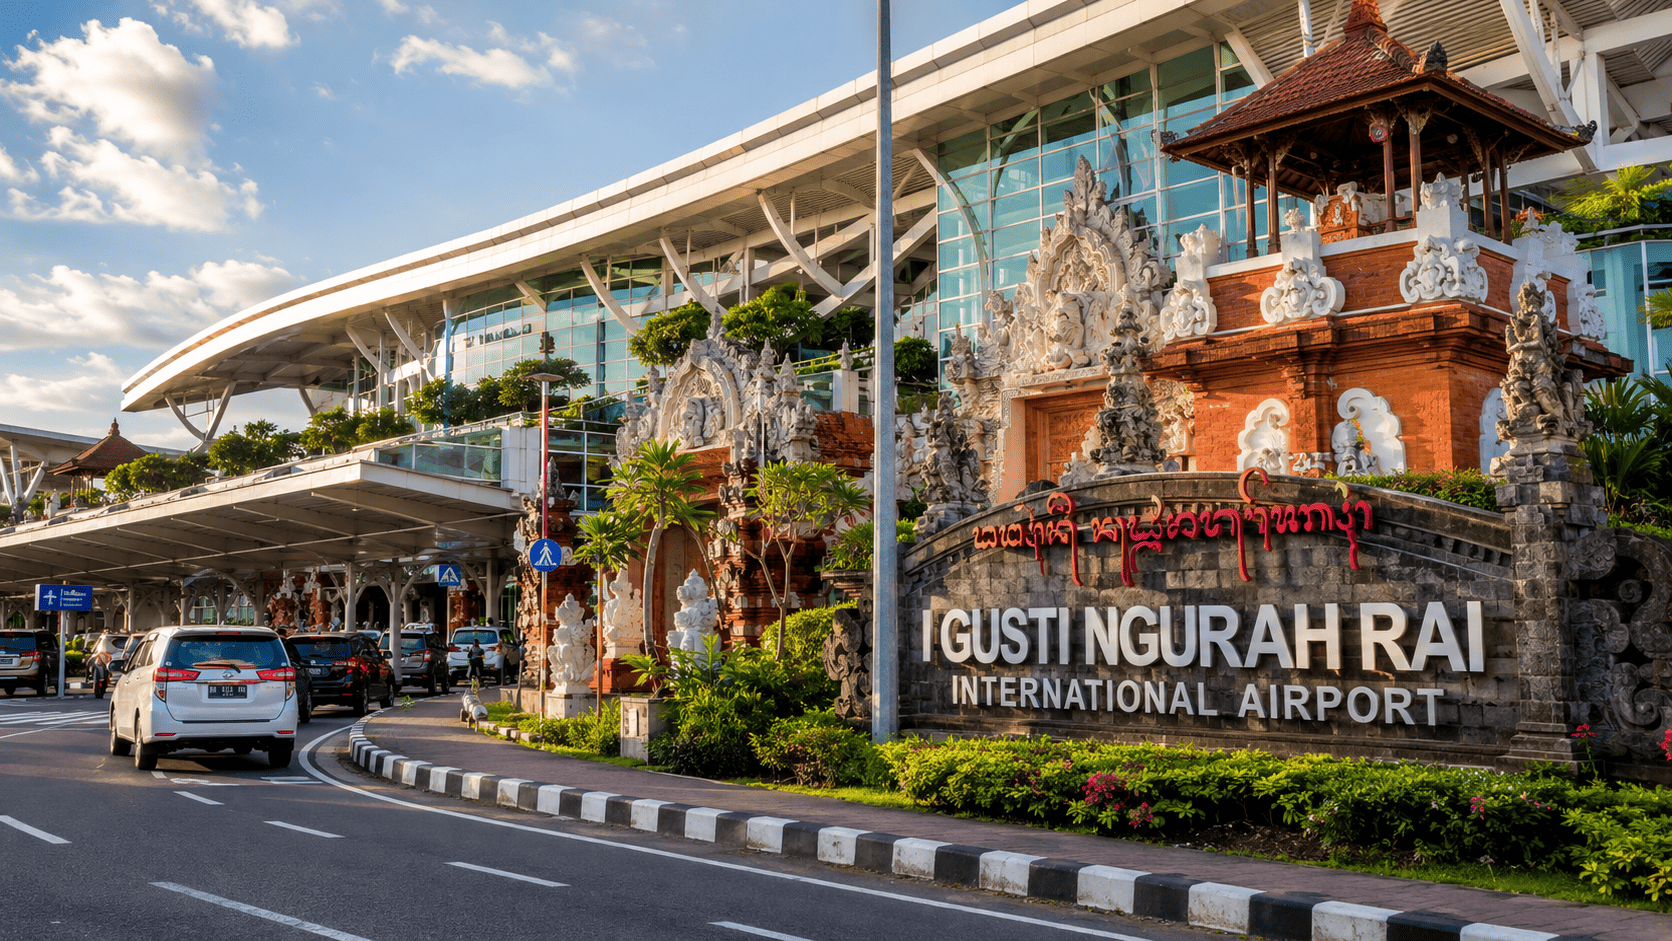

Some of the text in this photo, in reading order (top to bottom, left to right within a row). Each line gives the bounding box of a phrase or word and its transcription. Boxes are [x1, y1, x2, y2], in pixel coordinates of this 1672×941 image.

[922, 601, 1485, 672] I GUSTI NGURAH RAI
[952, 675, 1445, 726] INTERNATIONAL AIRPORT
